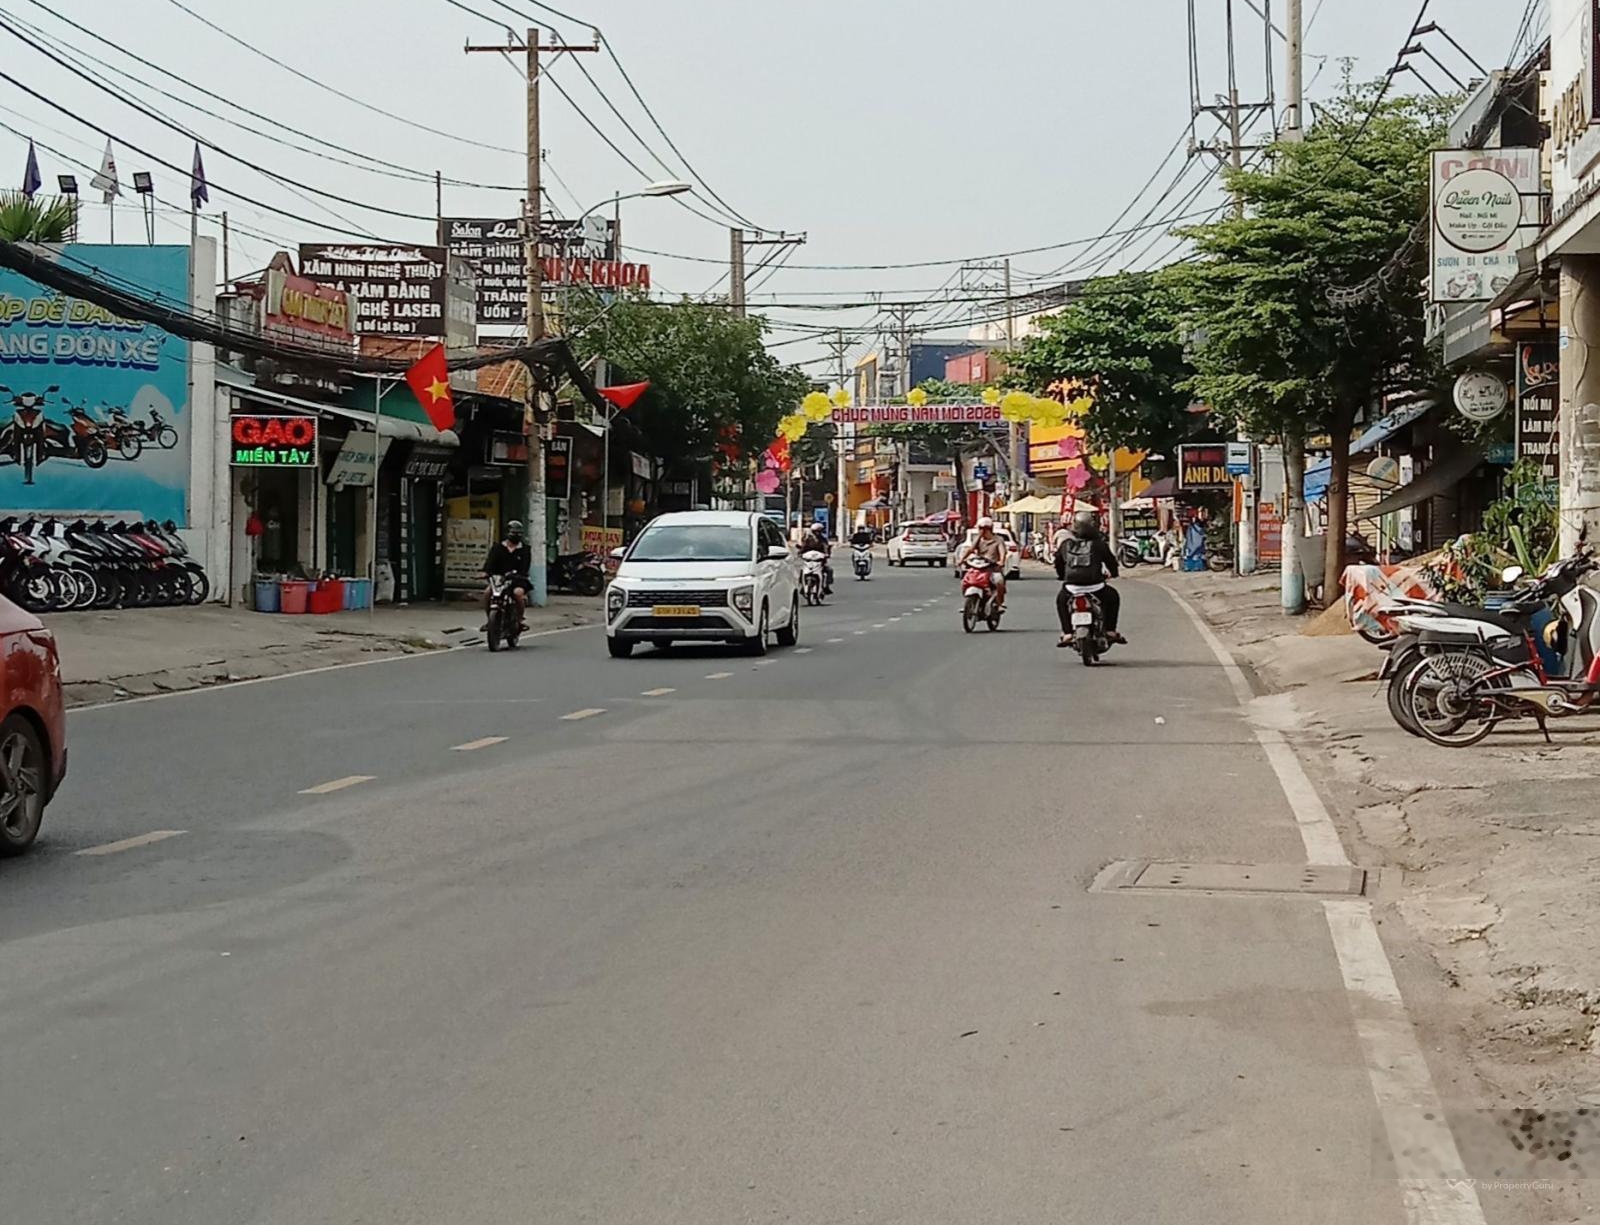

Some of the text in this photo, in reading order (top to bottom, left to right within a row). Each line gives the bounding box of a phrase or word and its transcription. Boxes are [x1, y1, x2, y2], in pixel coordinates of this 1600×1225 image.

[1444, 190, 1512, 210] Queen Nails
[451, 222, 482, 238] Salon
[303, 259, 332, 276] XĂM
[368, 263, 400, 280] NGHỆ
[404, 261, 443, 280] THUẬT
[591, 260, 651, 288] KHOA
[350, 281, 385, 298] XĂM
[394, 303, 442, 317] LASER
[55, 328, 118, 362] ĐÓN
[1523, 394, 1552, 411] NỐI MI
[966, 406, 1001, 420] 2026
[233, 418, 314, 447] GẠO
[1523, 418, 1546, 432] LÀM
[278, 448, 310, 464] TÂY
